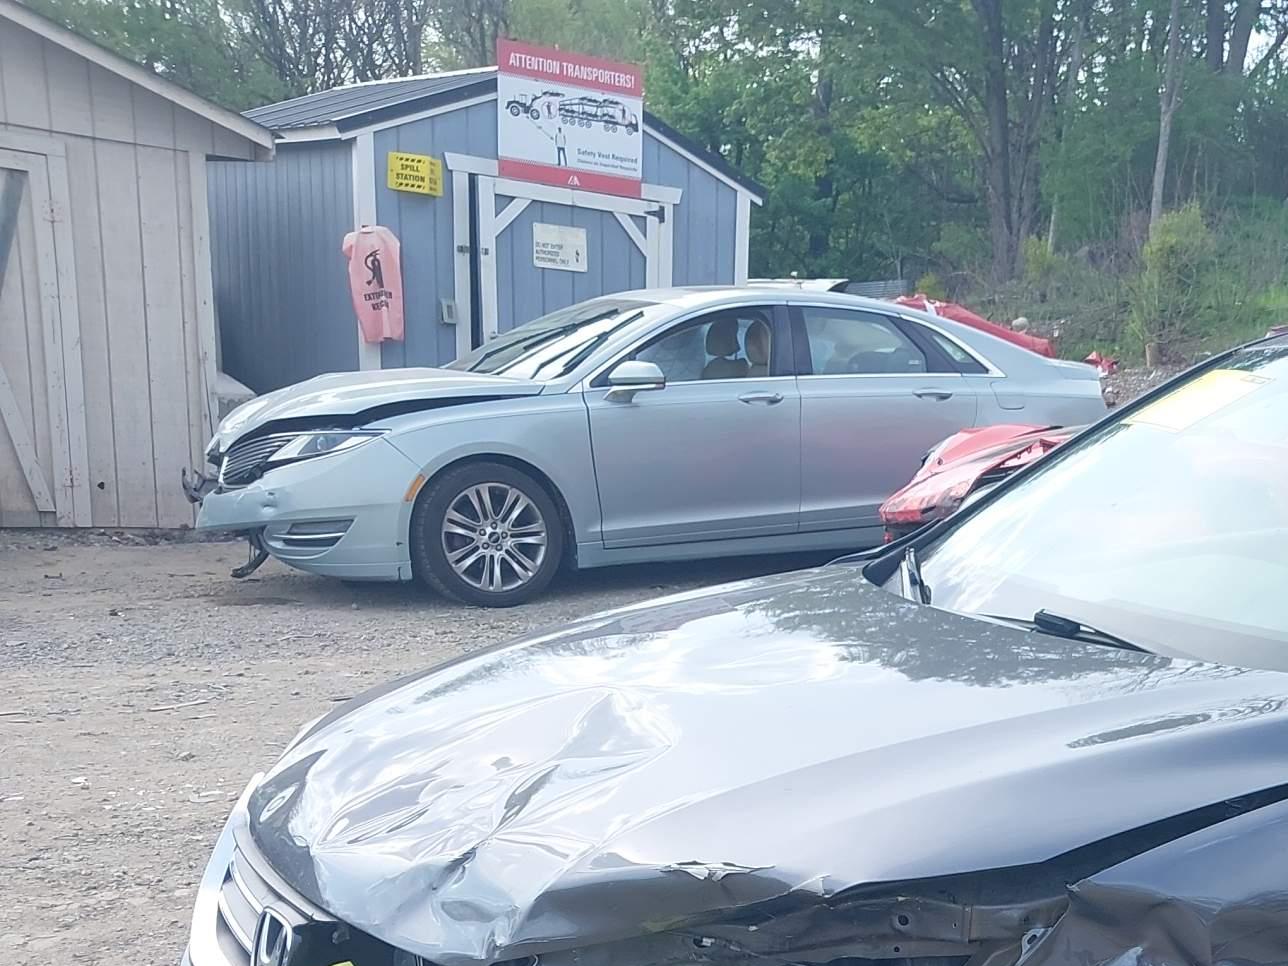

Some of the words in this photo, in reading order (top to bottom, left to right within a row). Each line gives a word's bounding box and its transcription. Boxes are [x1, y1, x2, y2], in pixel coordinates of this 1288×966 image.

[509, 52, 560, 75] ATTENTION
[562, 62, 635, 88] TRANSPORTERS!
[577, 148, 596, 158] Safety
[598, 152, 610, 160] Vest
[612, 154, 638, 164] Required
[400, 163, 420, 173] SPILL
[395, 172, 425, 183] STATION
